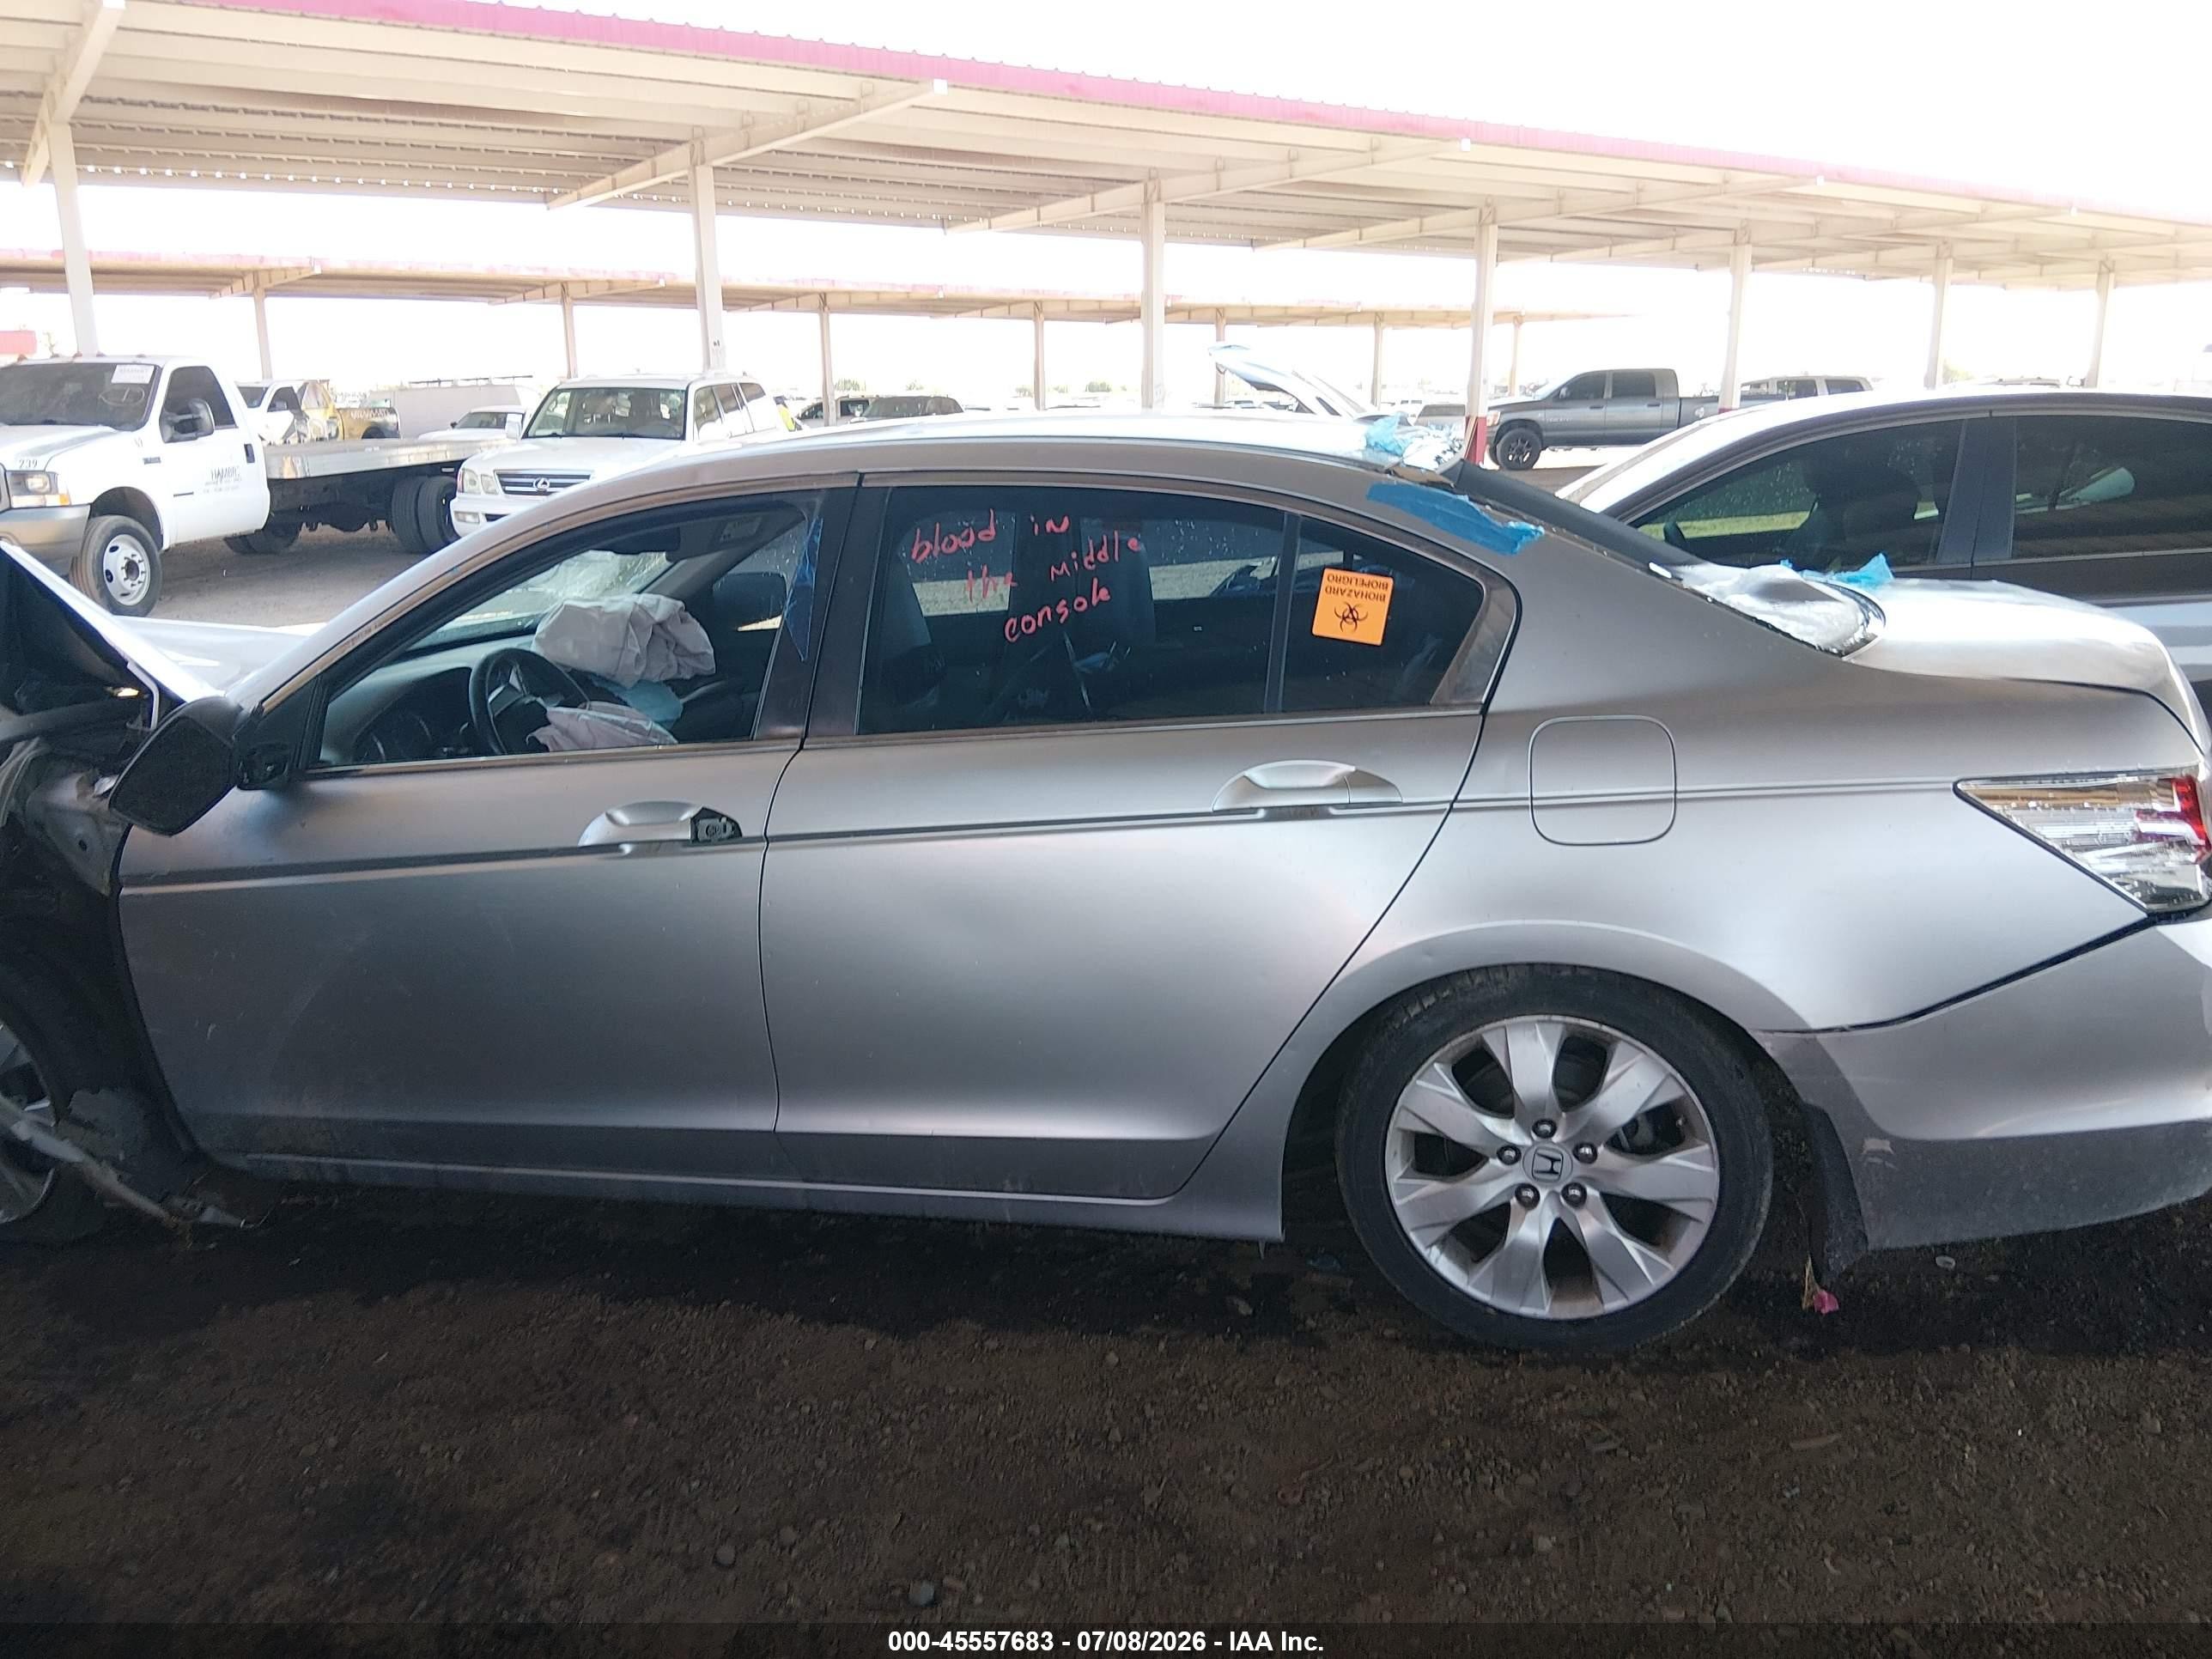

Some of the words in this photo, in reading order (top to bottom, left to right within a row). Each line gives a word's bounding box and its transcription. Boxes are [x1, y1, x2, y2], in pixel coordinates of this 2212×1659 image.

[911, 508, 996, 563] blood
[1324, 585, 1386, 602] BIOHAZARD
[1327, 574, 1389, 591] BIOPELIGRO
[1005, 577, 1111, 643] console
